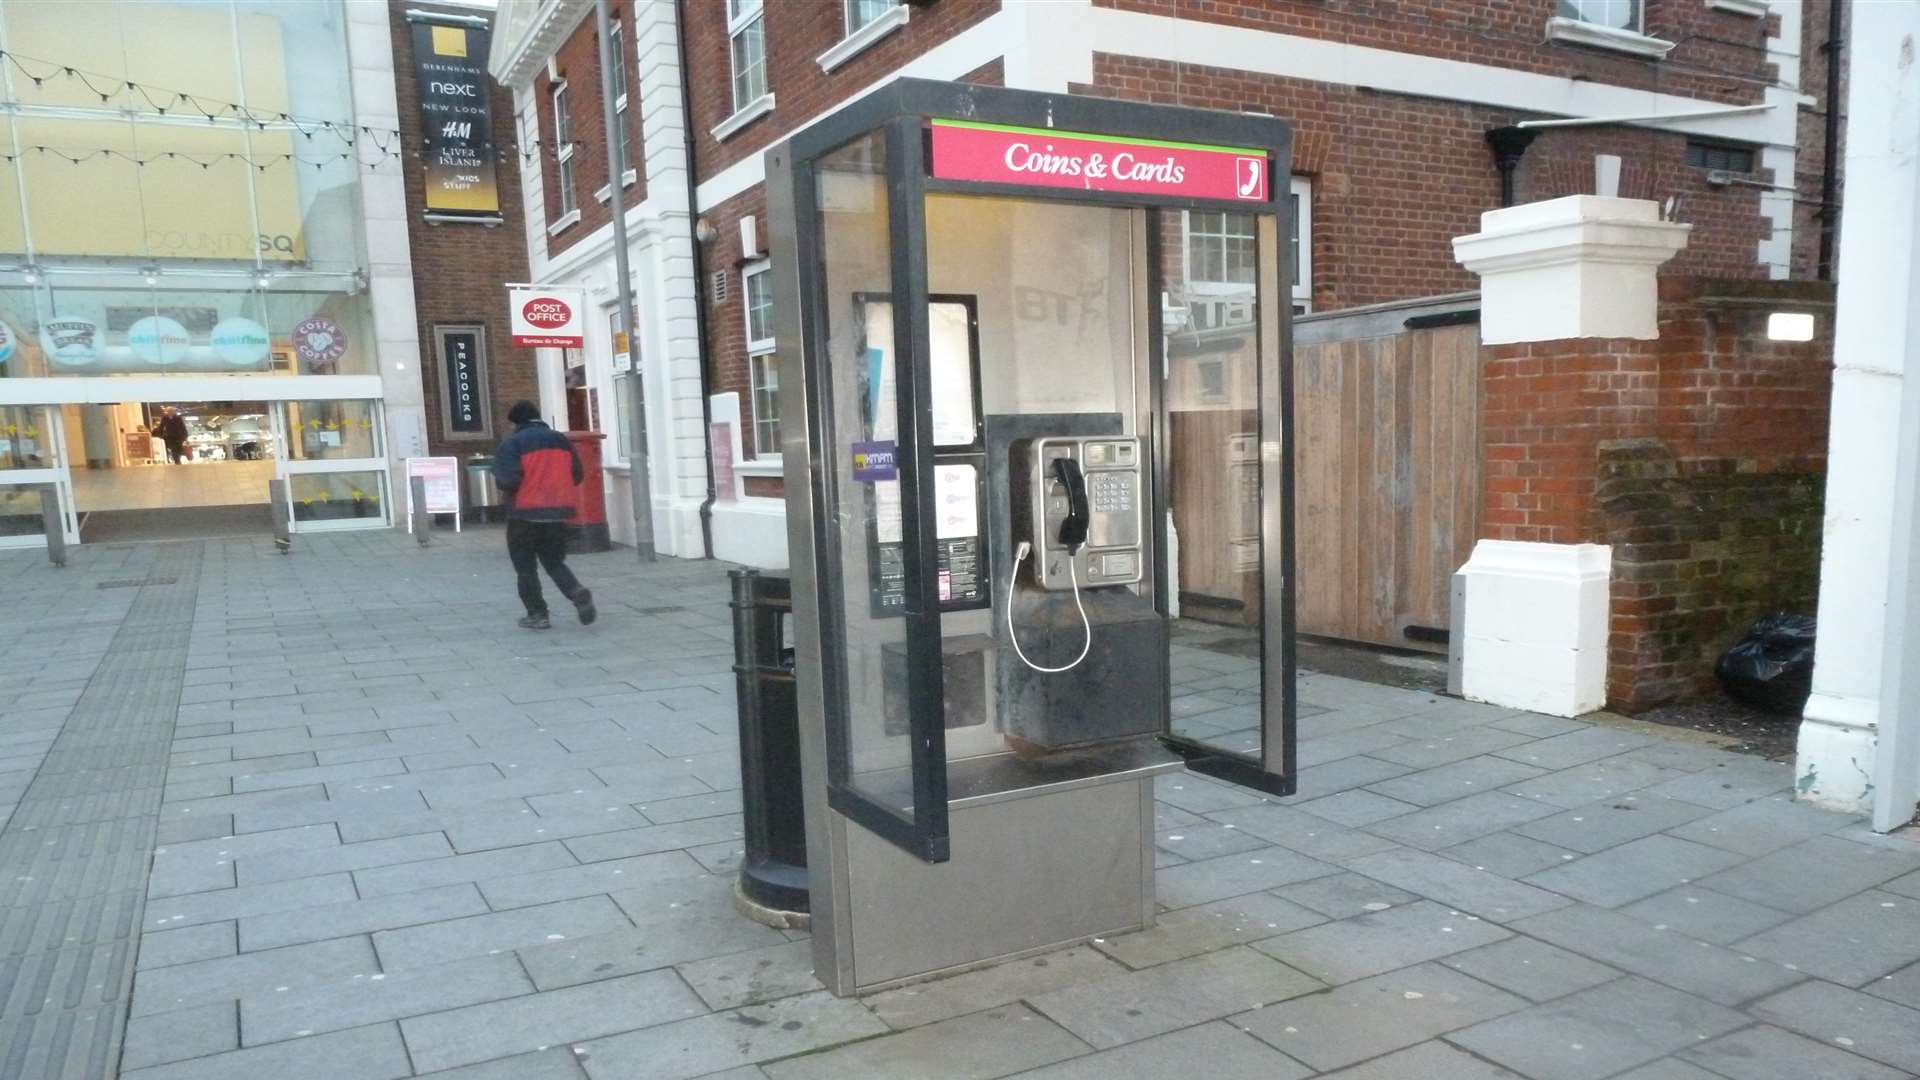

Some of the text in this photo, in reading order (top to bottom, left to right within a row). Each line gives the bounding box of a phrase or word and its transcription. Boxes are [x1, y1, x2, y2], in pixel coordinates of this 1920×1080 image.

[422, 63, 481, 74] DEBENHAMS
[431, 81, 476, 97] next
[422, 103, 486, 115] NEW LOOK
[442, 121, 472, 139] H&M
[1005, 143, 1185, 183] Coins & Cards
[258, 234, 294, 253] SQ
[533, 303, 562, 313] POST
[527, 312, 567, 322] OFFICE
[299, 322, 335, 334] COSTA
[457, 342, 472, 421] PEACOCKS
